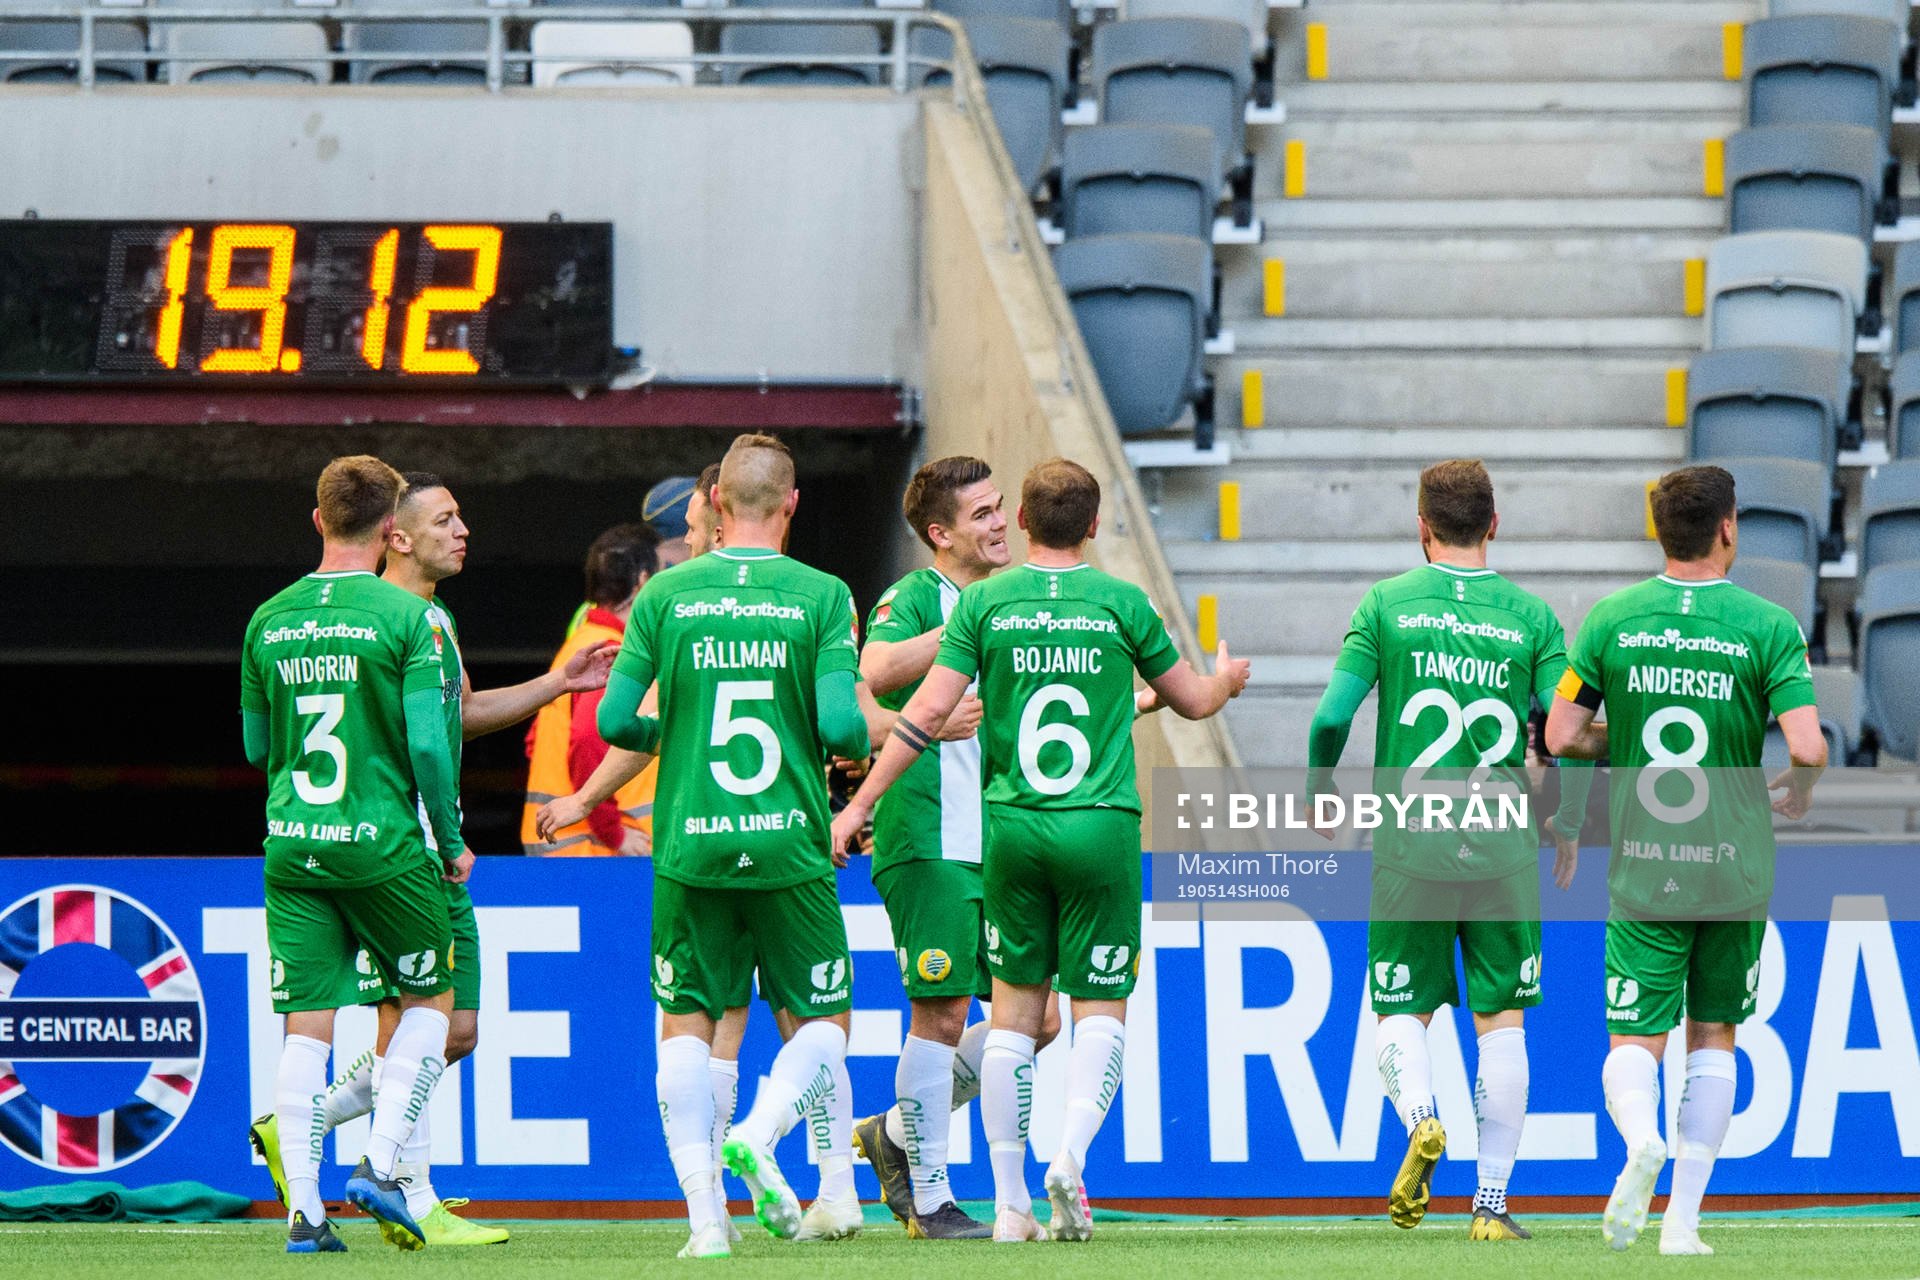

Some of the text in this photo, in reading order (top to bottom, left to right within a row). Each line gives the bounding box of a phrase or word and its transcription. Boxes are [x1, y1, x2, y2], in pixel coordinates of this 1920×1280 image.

[674, 602, 805, 621] Sefina pantbank
[991, 616, 1118, 634] Sefina pantbank
[264, 624, 378, 645] Sefina pantbank
[1398, 613, 1525, 645] Sefina pantbank
[692, 636, 787, 670] FÄLLMAN
[1618, 632, 1749, 658] Sefina pantbank
[1013, 647, 1102, 675] BOJANIC
[1411, 647, 1511, 690] TANKOVIĆ
[1627, 665, 1735, 701] ANDERSEN
[291, 693, 346, 805] 3
[709, 680, 782, 796] 5
[1018, 683, 1091, 795] 6
[1399, 688, 1519, 799] 22
[1636, 705, 1710, 824] 8
[268, 819, 352, 842] SILJA LINE
[685, 813, 785, 835] SILJA LINE
[1622, 840, 1713, 864] SILJA LINE
[811, 989, 848, 1004] fronta
[1374, 990, 1413, 1003] fronta
[20, 1017, 135, 1042] CENTRAL
[141, 1017, 193, 1042] BAR
[896, 1097, 925, 1168] Clinton
